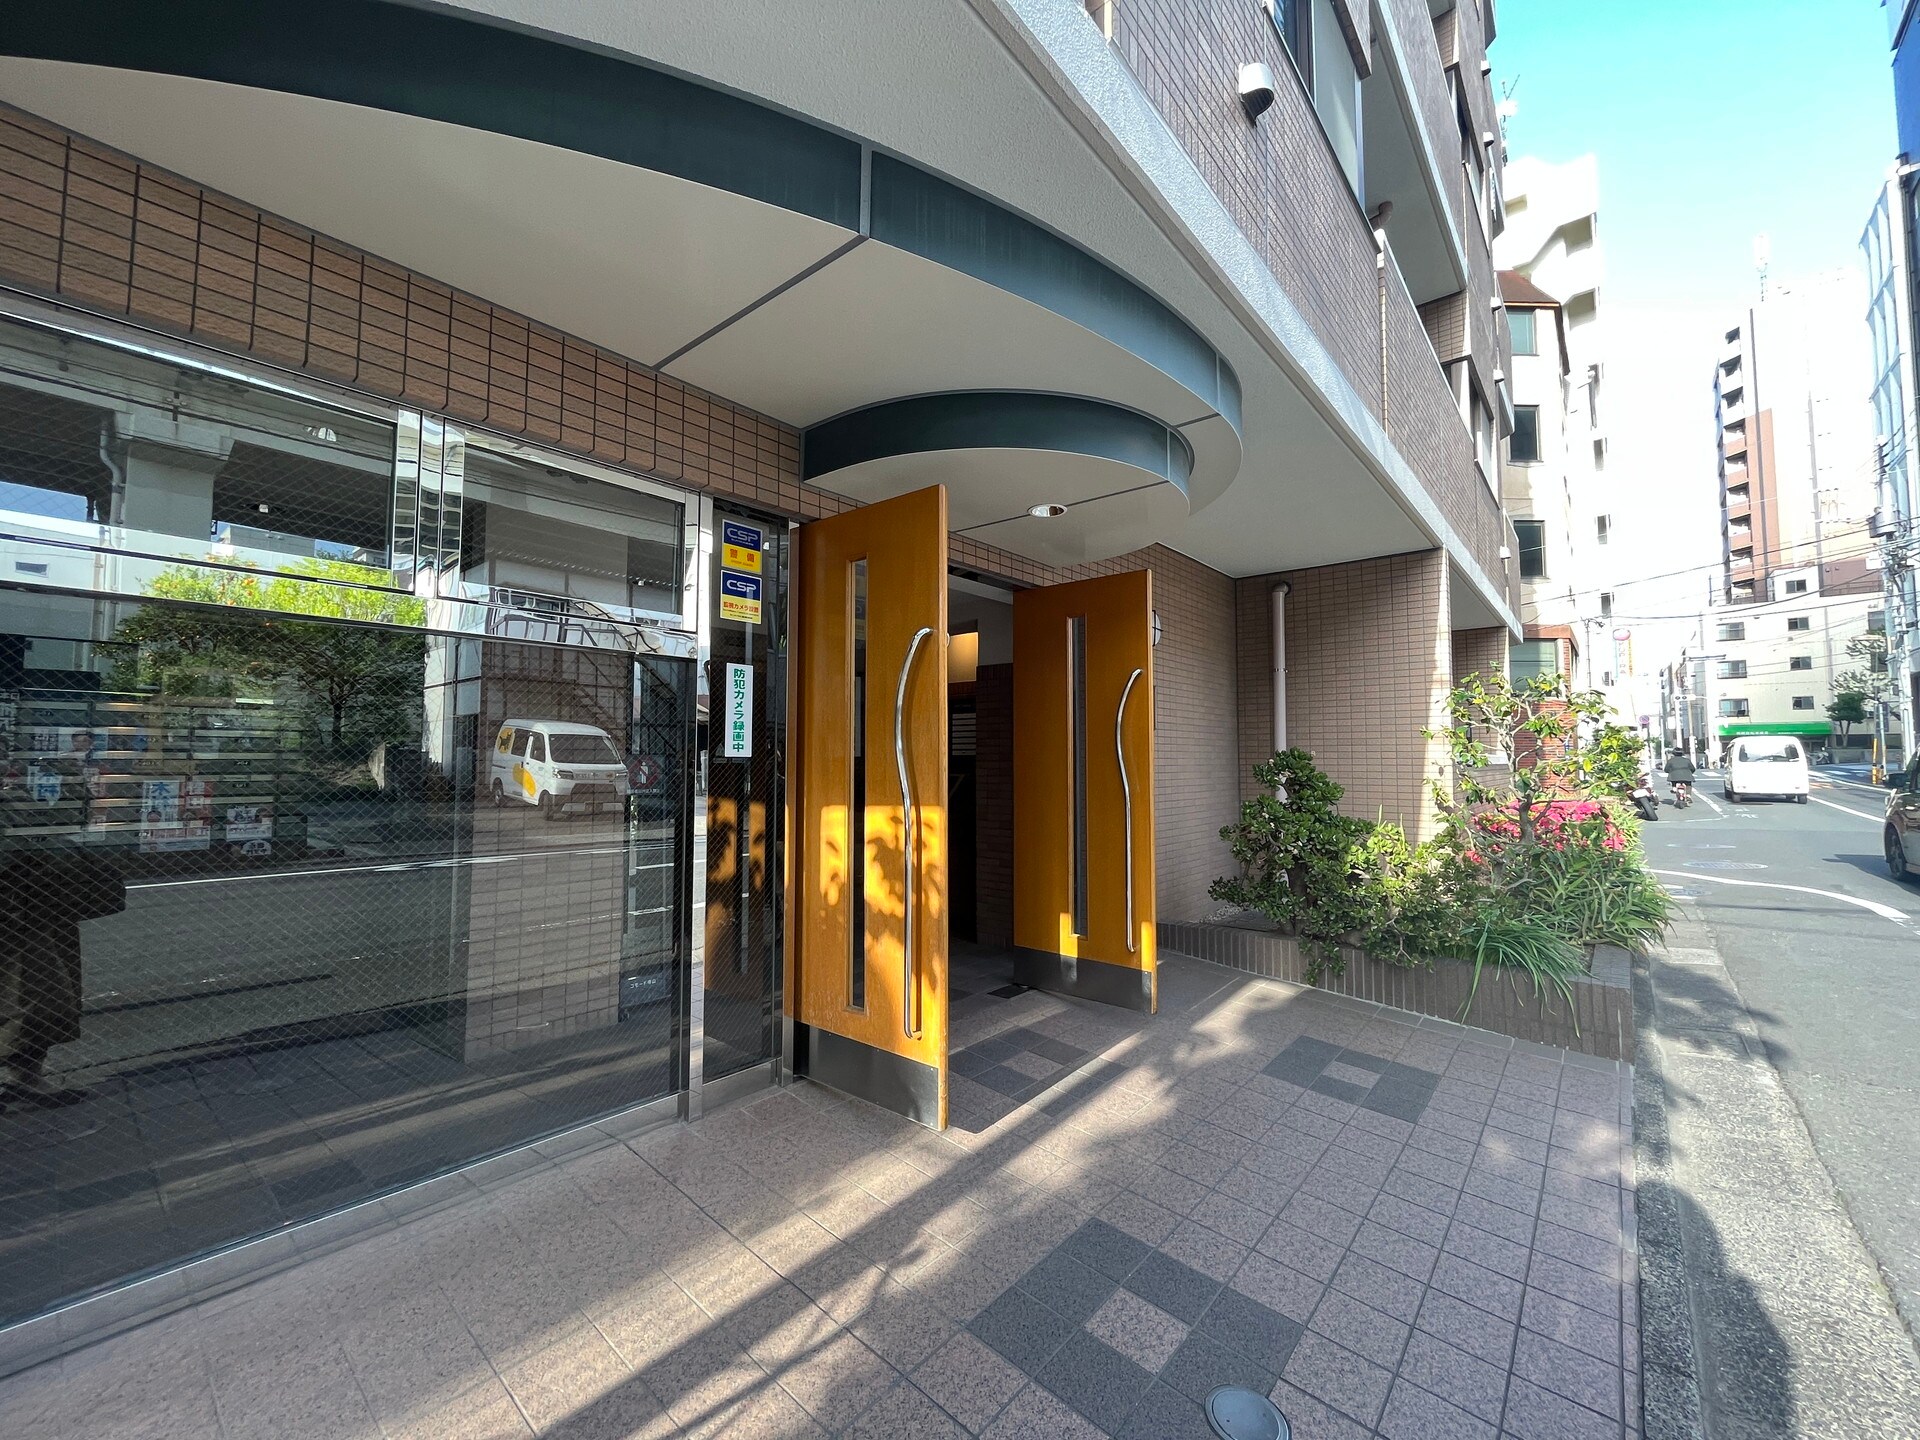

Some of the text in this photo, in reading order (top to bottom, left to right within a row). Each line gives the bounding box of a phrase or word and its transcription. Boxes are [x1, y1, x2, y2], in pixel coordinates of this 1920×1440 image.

[727, 527, 758, 542] CSP
[726, 579, 757, 593] CSP
[733, 668, 746, 752] 防犯カメラ録画中
